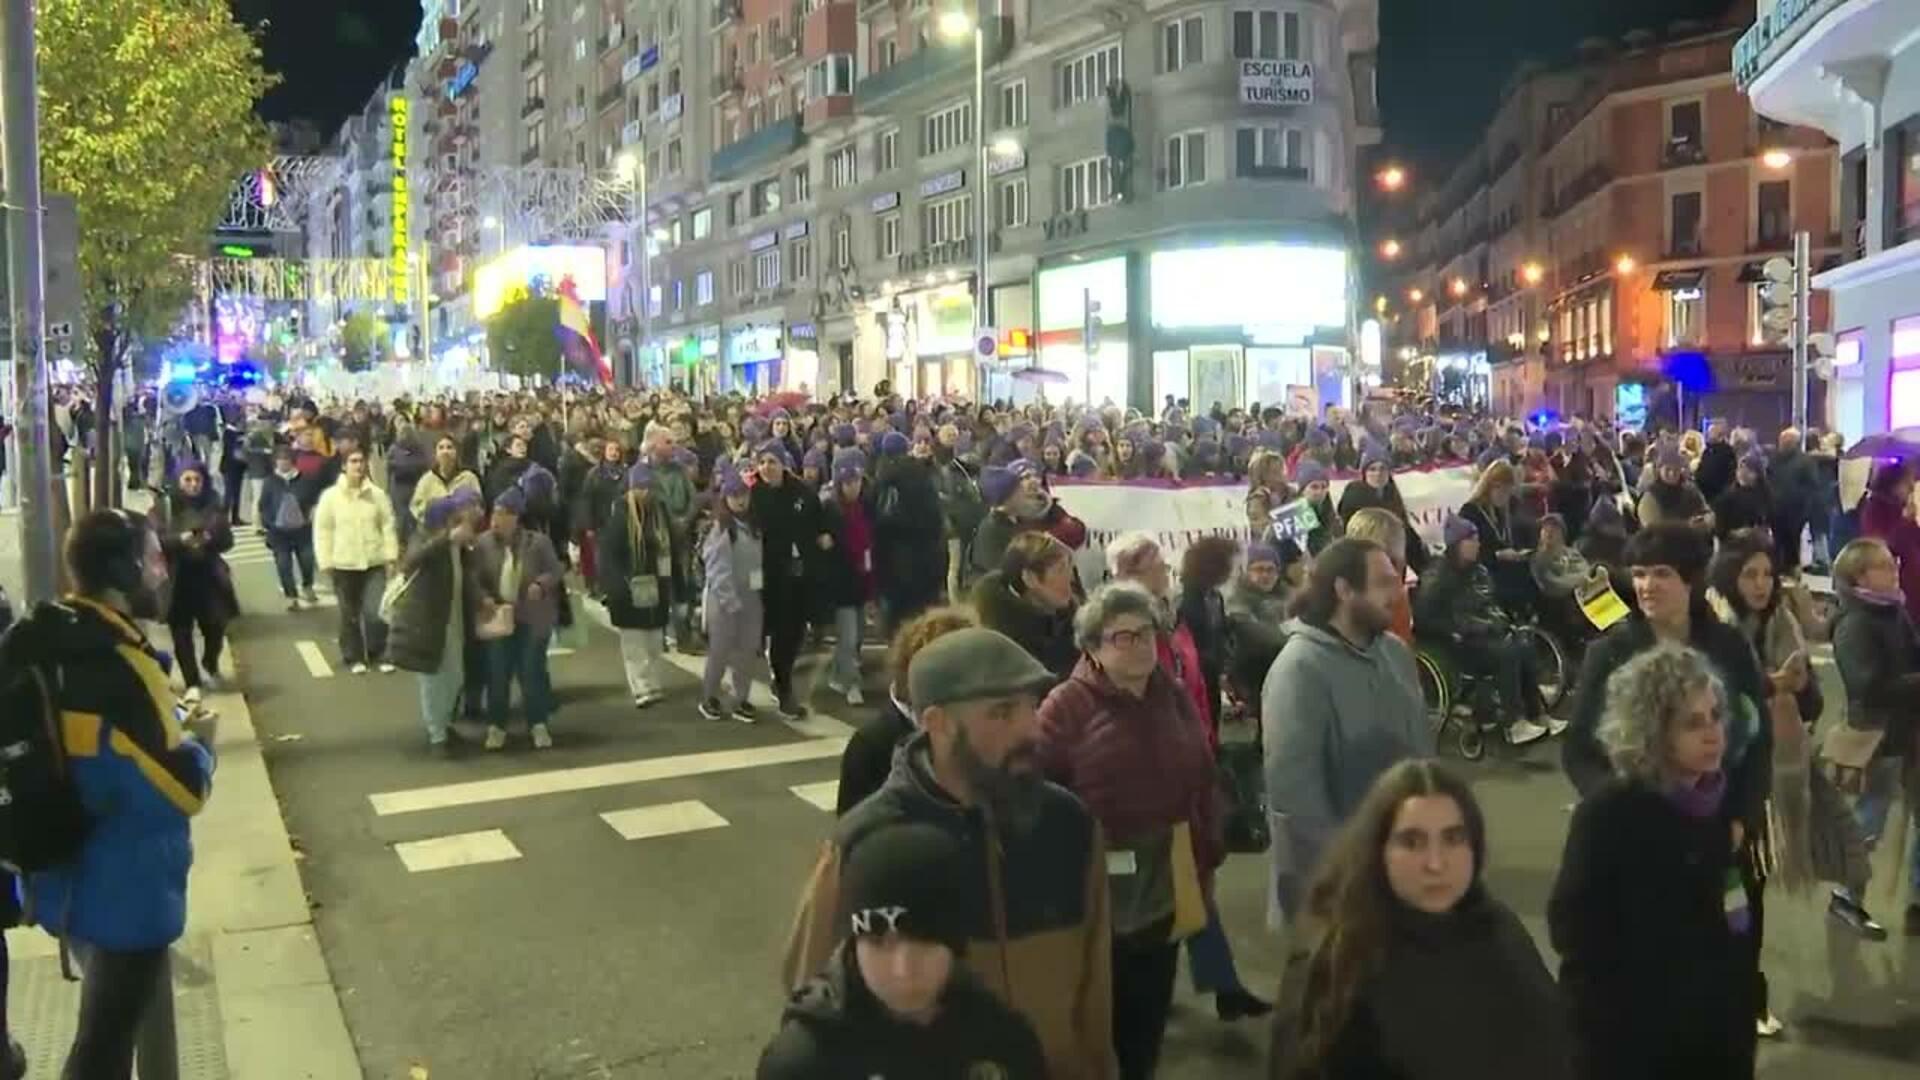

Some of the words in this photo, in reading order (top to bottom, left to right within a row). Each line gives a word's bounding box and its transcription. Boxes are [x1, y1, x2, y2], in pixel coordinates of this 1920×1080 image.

[1243, 62, 1311, 77] ESCUELA
[1246, 86, 1311, 102] TURISMO
[851, 906, 907, 935] NY
